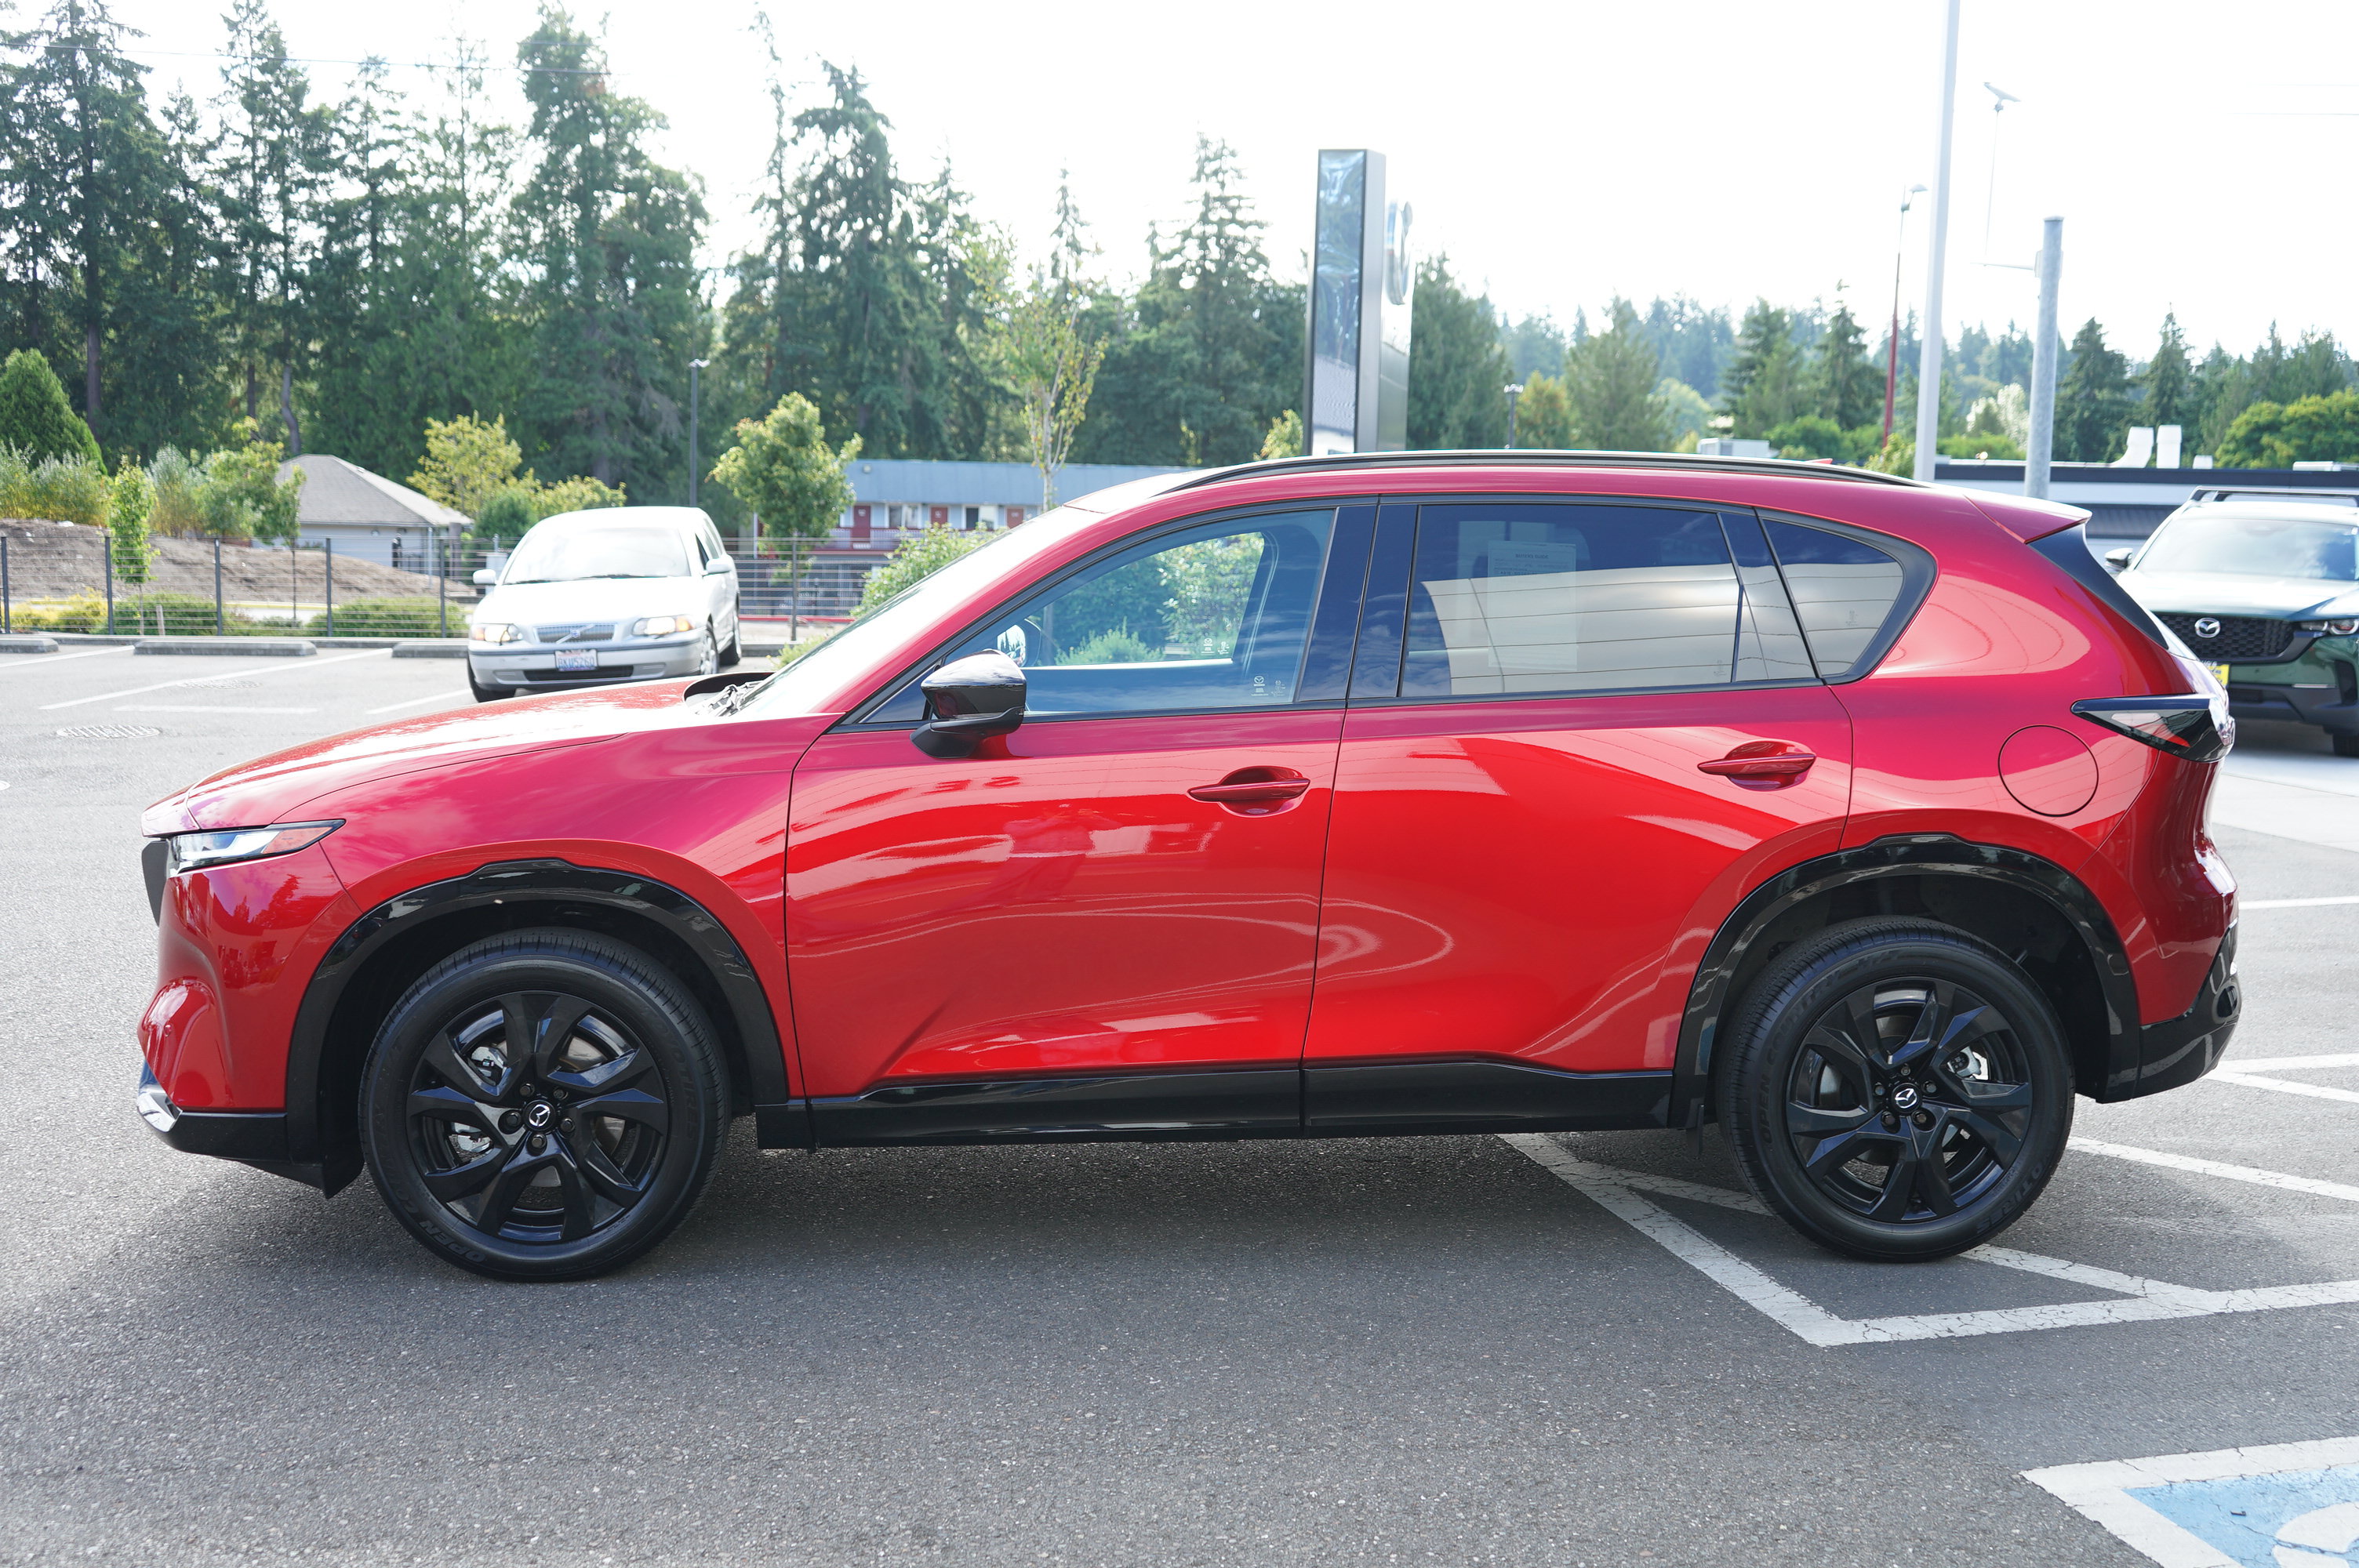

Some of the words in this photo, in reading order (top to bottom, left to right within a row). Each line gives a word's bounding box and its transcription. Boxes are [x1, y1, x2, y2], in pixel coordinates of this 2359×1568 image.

[678, 1064, 700, 1142] TIRES
[1757, 1074, 1773, 1144] OPEN
[1976, 1180, 2033, 1235] TIRES
[419, 1220, 485, 1262] OPEN
